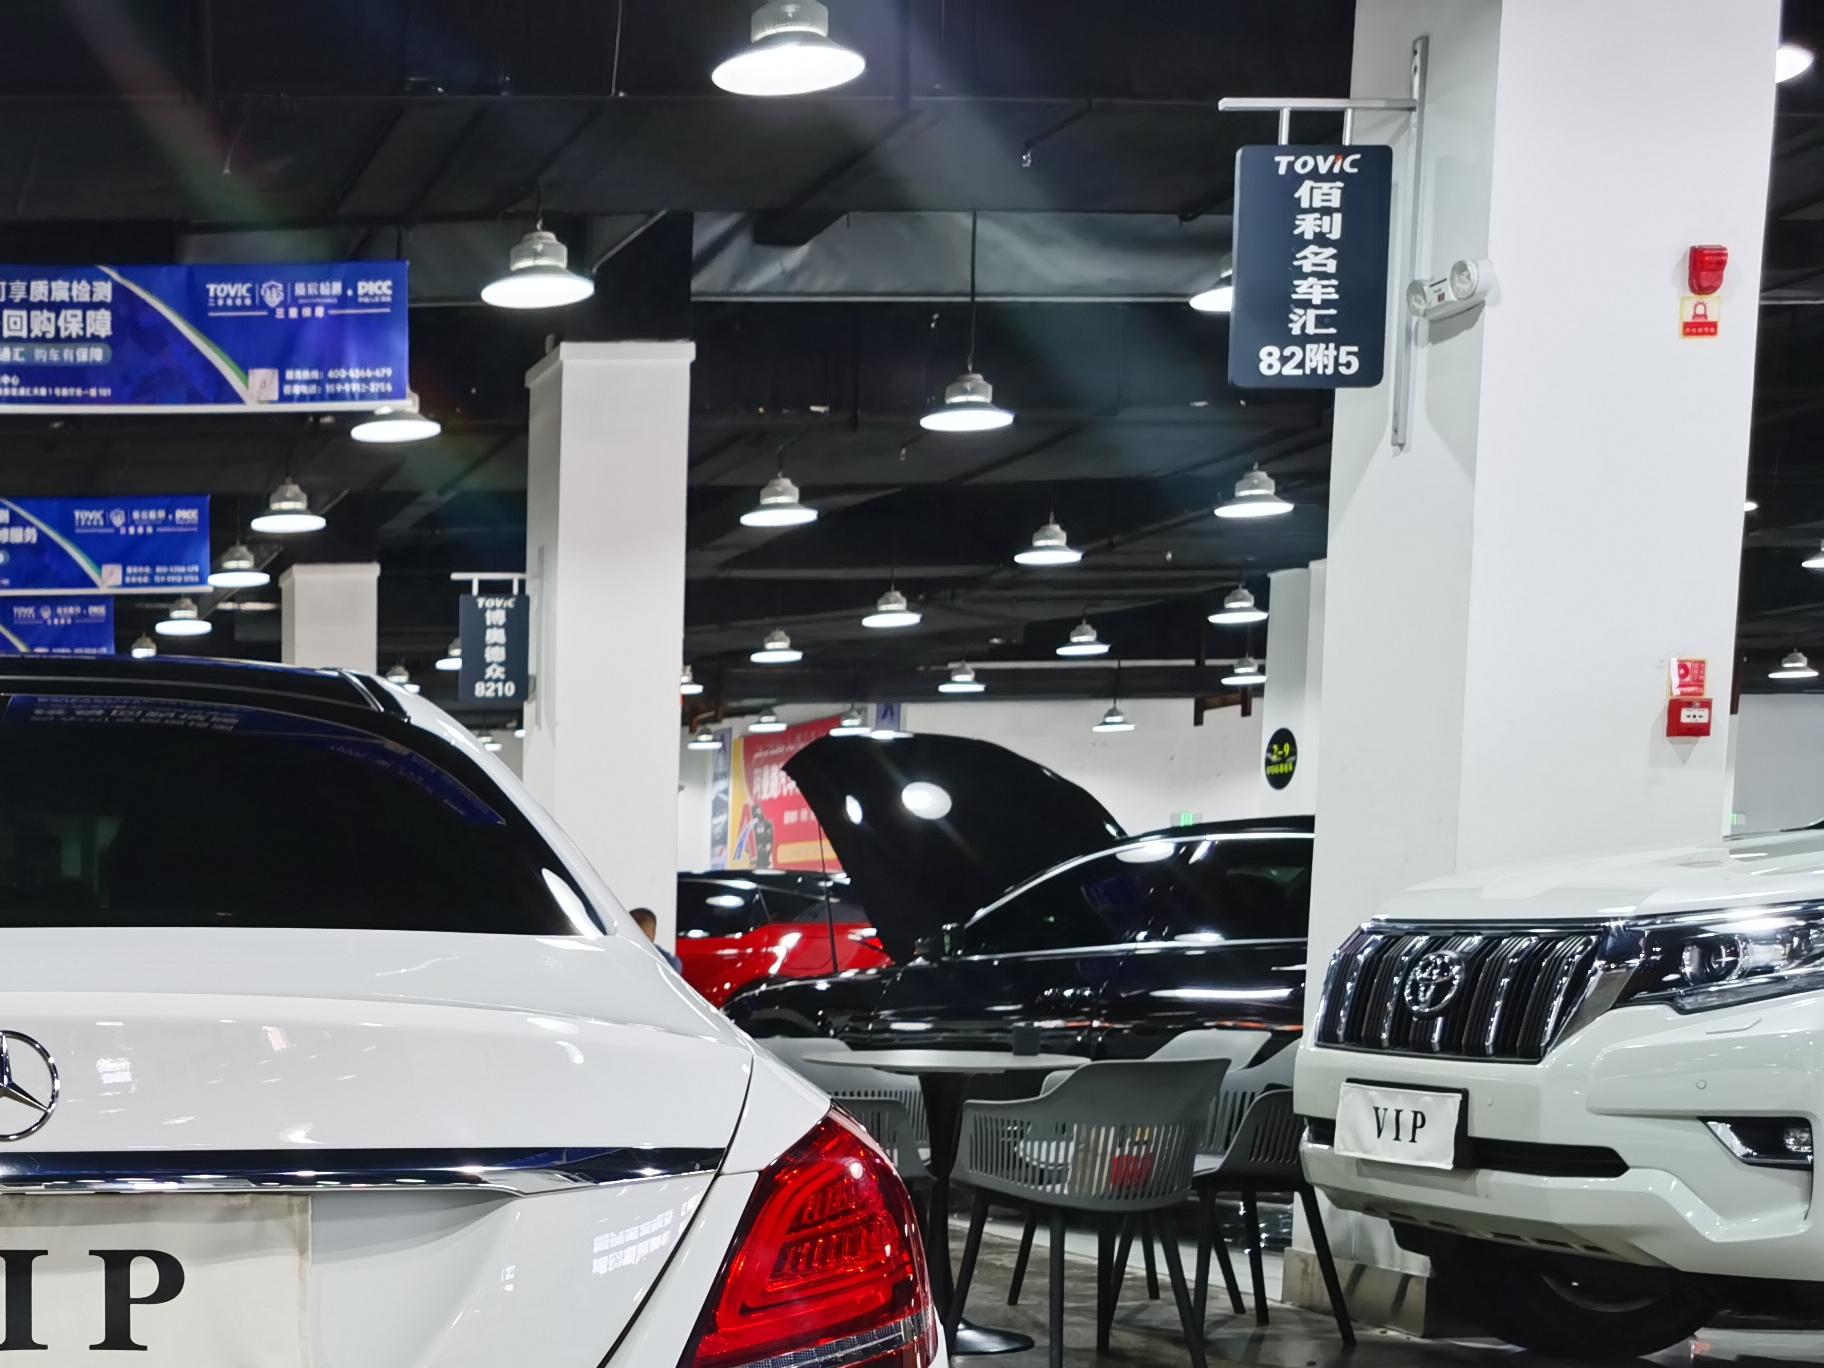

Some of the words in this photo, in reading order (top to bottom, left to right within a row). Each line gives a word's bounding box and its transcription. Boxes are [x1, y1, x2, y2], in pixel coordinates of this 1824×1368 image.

[1274, 153, 1362, 175] TOVIC
[1288, 179, 1344, 336] 佰利名车汇
[206, 283, 252, 297] TOVIC
[1258, 342, 1360, 377] 82附5
[476, 597, 517, 609] TOVIC
[474, 681, 516, 698] 8210
[1373, 1106, 1427, 1144] VIP
